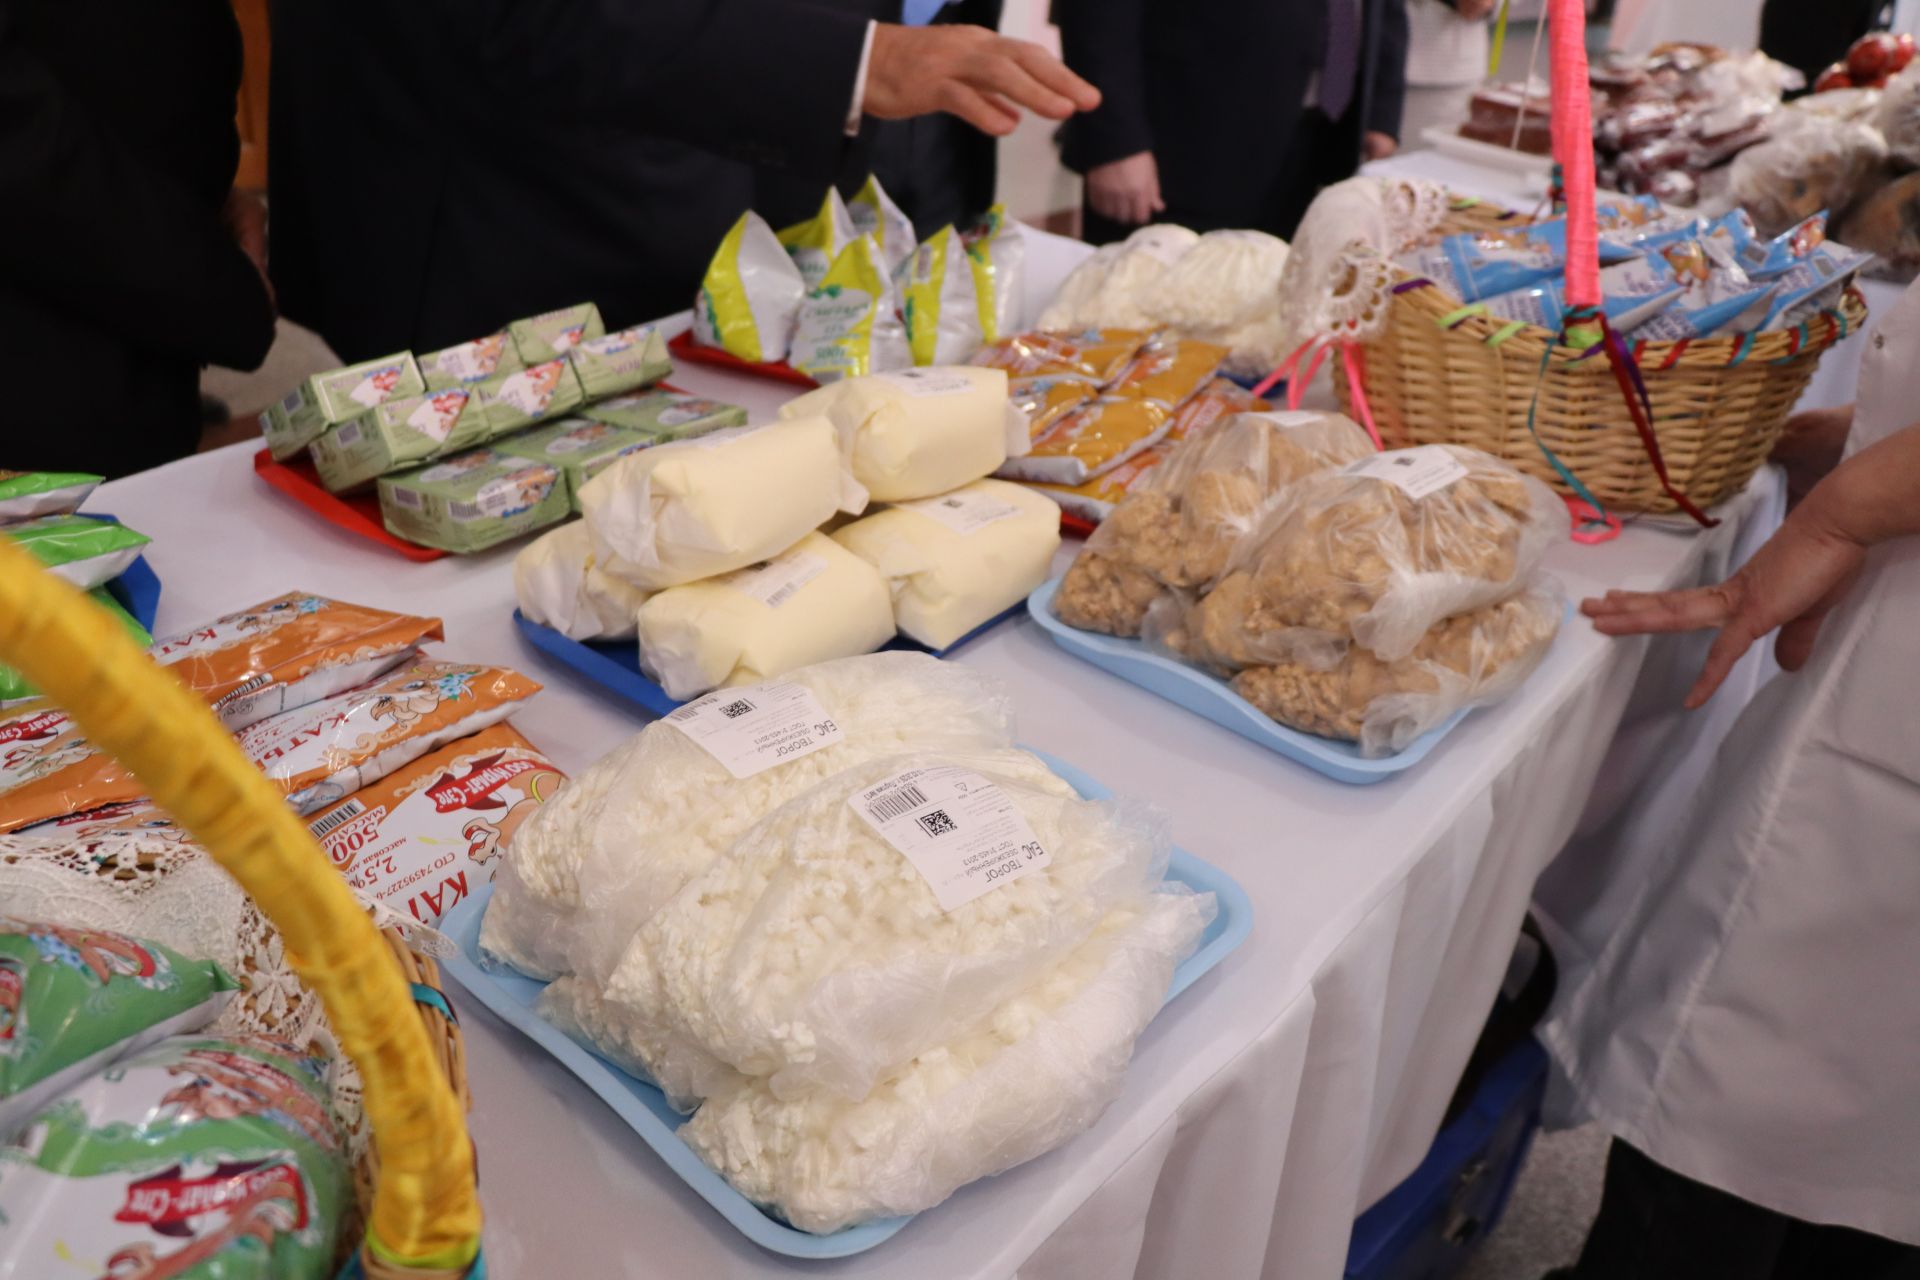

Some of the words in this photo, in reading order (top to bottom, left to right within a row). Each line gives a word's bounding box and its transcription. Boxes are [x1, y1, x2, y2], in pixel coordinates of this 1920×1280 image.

[158, 628, 217, 656] КАТ
[253, 711, 349, 771] КАТЫ
[776, 736, 815, 758] ТВОРОГ
[332, 822, 380, 863] 500
[985, 859, 1023, 883] ТВОРОГ
[398, 870, 468, 933] КАТ
